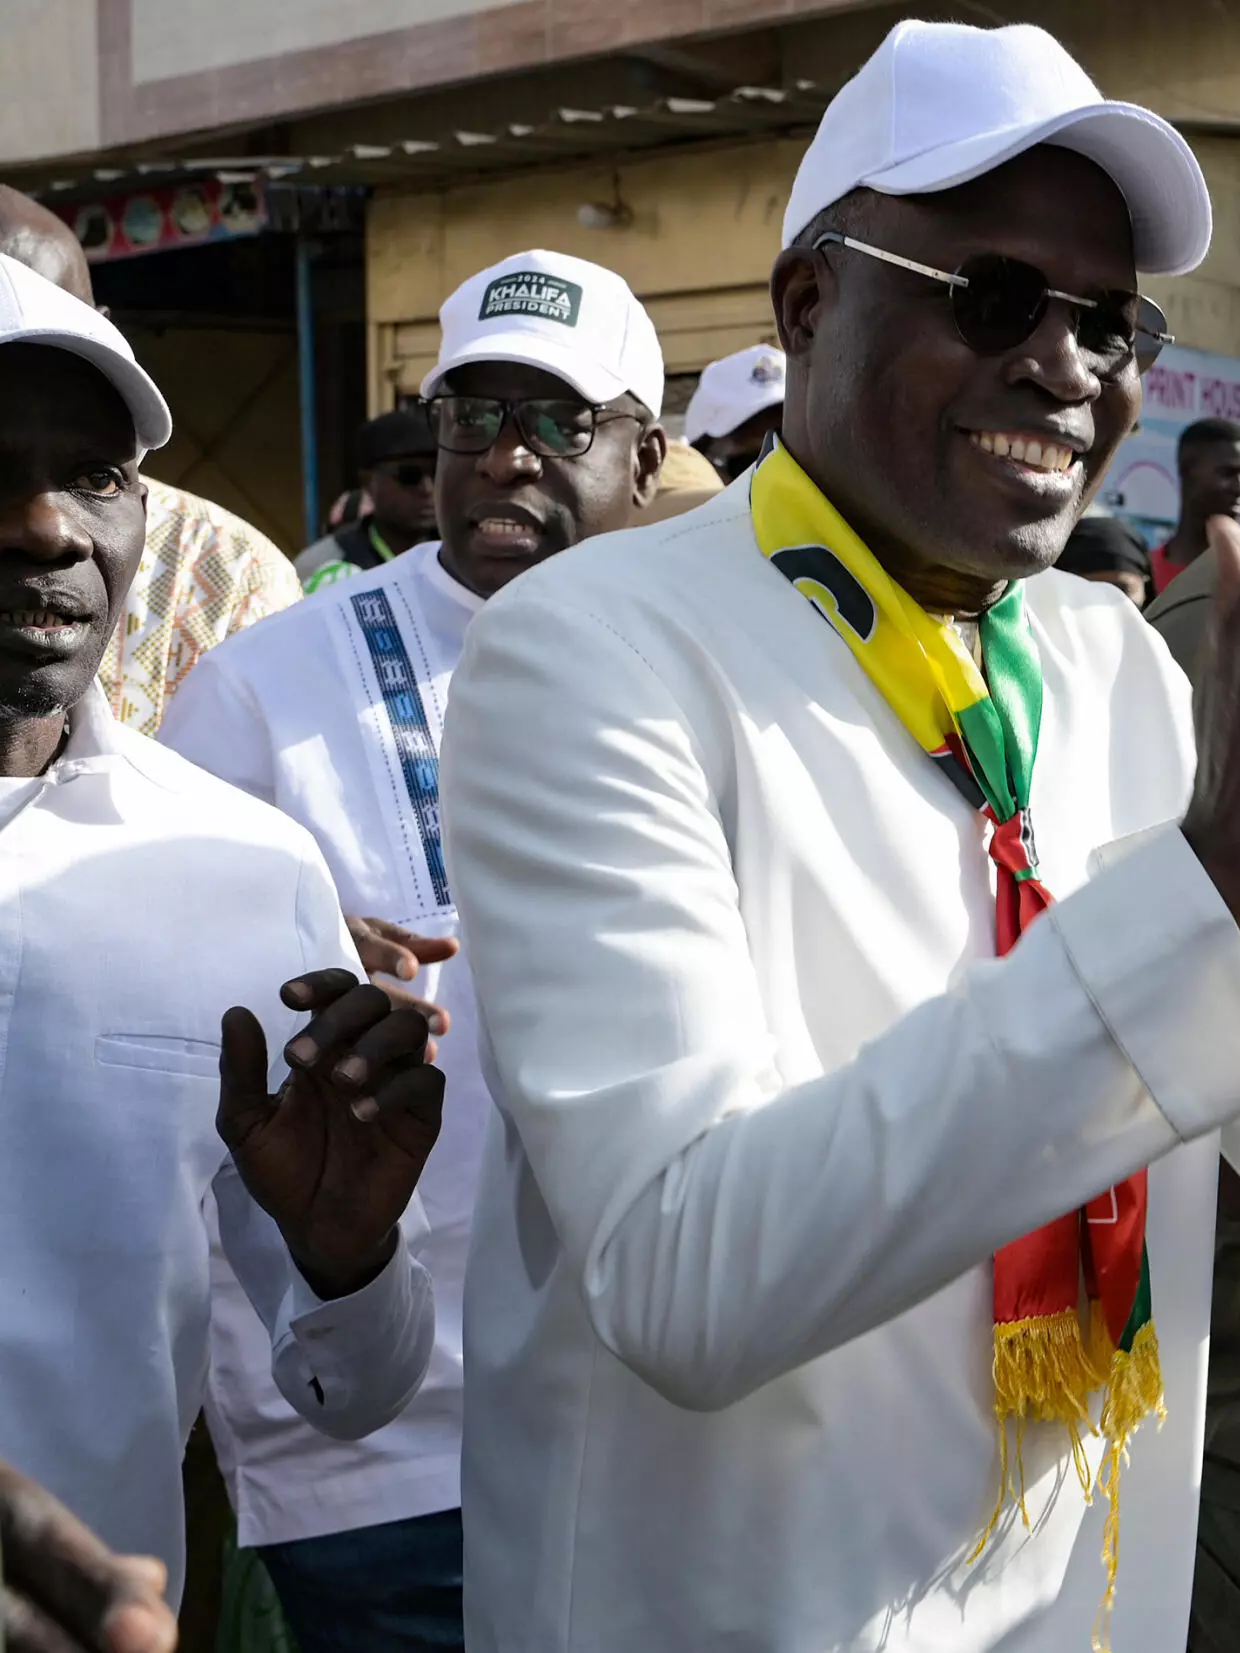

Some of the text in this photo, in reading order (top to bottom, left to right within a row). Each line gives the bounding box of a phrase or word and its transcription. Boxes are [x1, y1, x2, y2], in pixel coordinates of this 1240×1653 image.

[517, 274, 546, 284] 2024
[488, 283, 571, 308] KHALIFA
[485, 301, 571, 320] PRESIDENT
